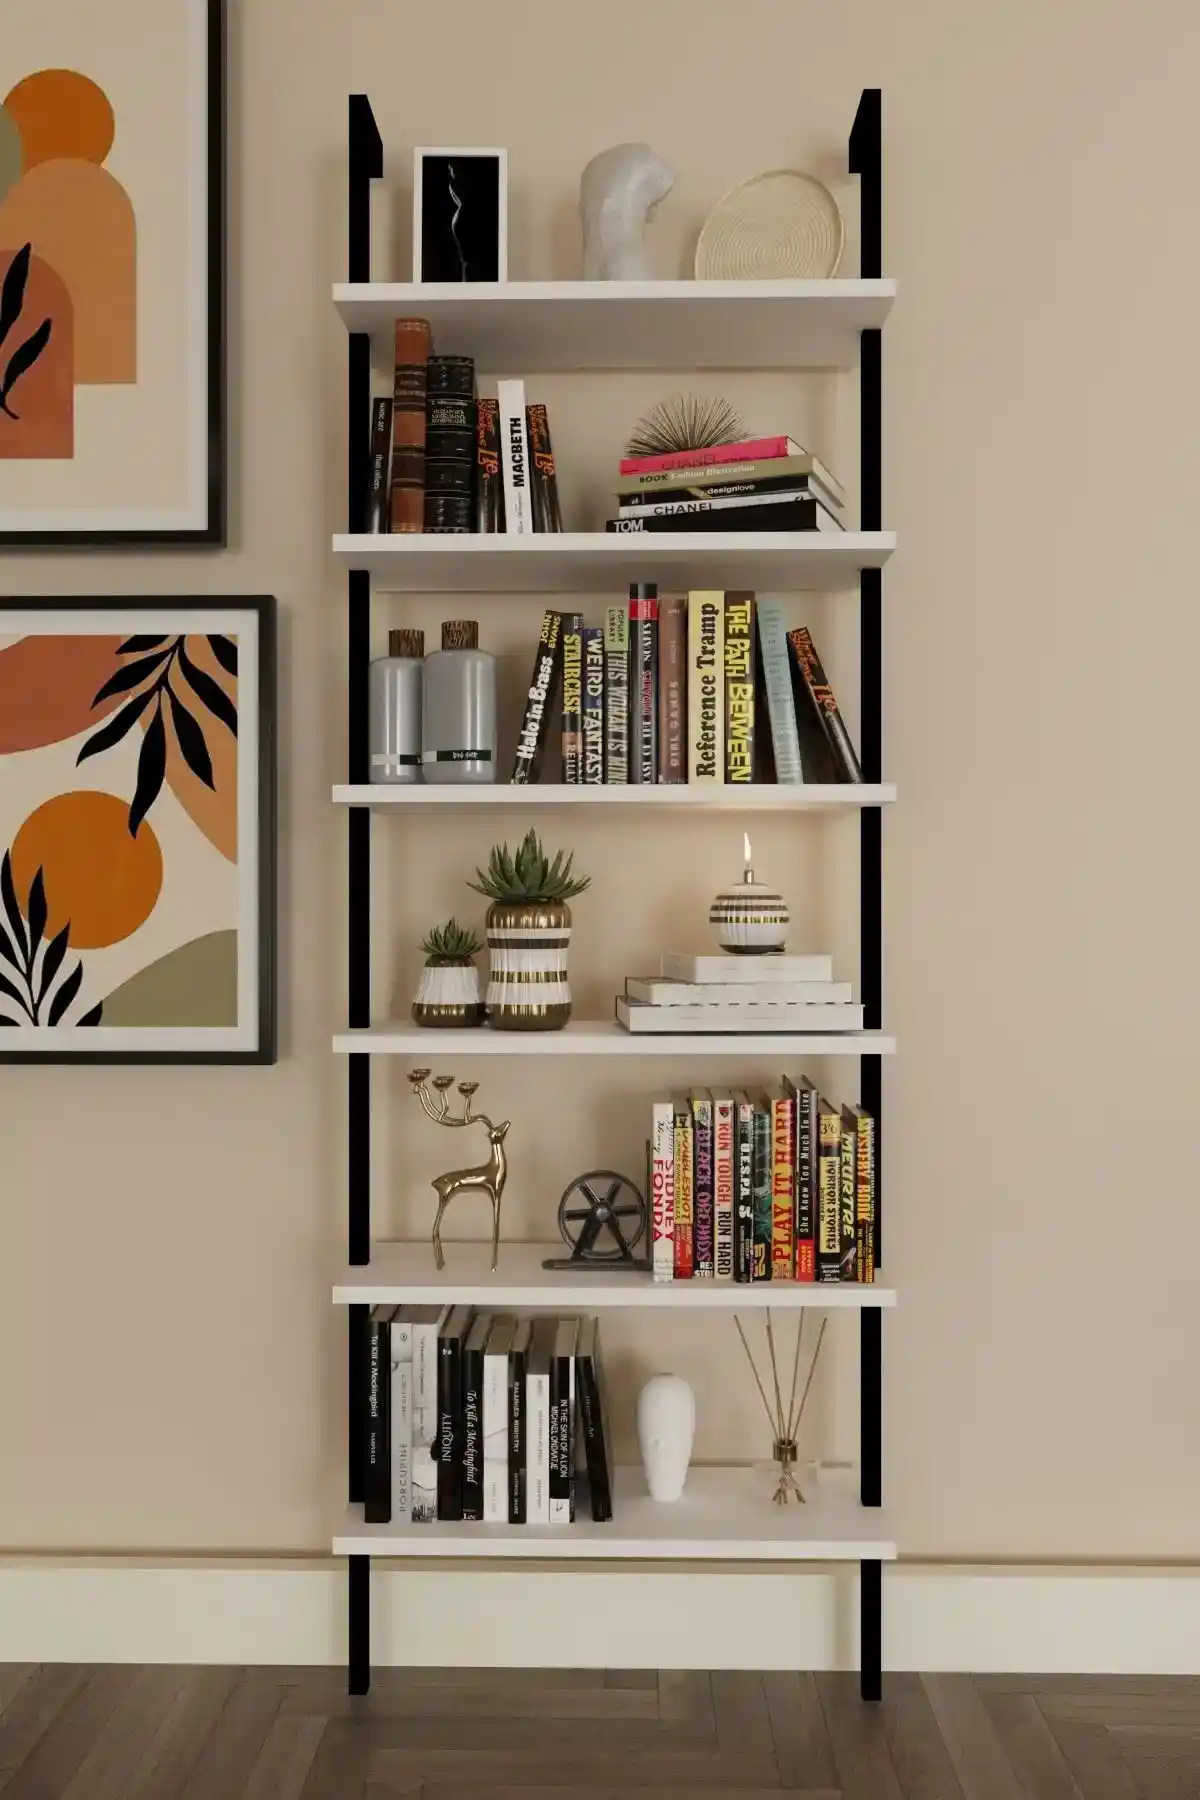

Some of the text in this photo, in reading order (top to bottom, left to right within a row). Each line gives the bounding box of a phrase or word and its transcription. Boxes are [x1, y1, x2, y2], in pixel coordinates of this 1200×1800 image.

[509, 417, 524, 488] MACBETH
[707, 484, 755, 496] designlove
[613, 519, 644, 533] TOM
[540, 614, 553, 644] JOHN
[548, 615, 561, 648] EVANS
[608, 609, 616, 643] LIBRARY
[616, 609, 625, 644] POPULAR
[528, 656, 553, 700] Brass
[563, 634, 581, 714] STAIRCASE
[607, 652, 628, 681] THIS
[526, 703, 544, 719] in
[582, 638, 604, 784] WEIRD FANTASY
[607, 686, 628, 732] WOMAN
[696, 602, 720, 778] Reference Tramp
[723, 600, 754, 782] THE PATH BETWEEN
[516, 722, 540, 759] Halo
[607, 736, 628, 751] IS
[670, 735, 680, 767] GIRL
[773, 1099, 792, 1166] HARD
[681, 1130, 691, 1221] DOUBLESHOT
[696, 1129, 712, 1186] BLACK
[800, 1093, 809, 1233] She Knew Too Much To Live
[857, 1118, 870, 1222] MYSTERY BOOK
[653, 1160, 664, 1242] FONDA
[716, 1123, 732, 1275] RUN TOUGH, RUN HARD
[773, 1173, 792, 1196] IT
[825, 1160, 837, 1204] HORROR
[841, 1133, 855, 1239] MEURTRE
[696, 1192, 712, 1262] ORCHIDS
[773, 1204, 792, 1261] PLAY
[825, 1207, 837, 1250] STORIES
[370, 1335, 379, 1344] To
[370, 1346, 379, 1359] Kill
[369, 1367, 379, 1418] Mockingbird
[464, 1403, 478, 1421] Kill
[466, 1391, 477, 1402] To
[560, 1399, 568, 1407] IN
[550, 1406, 559, 1434] MICHAEL
[560, 1408, 568, 1422] THE
[560, 1424, 568, 1441] SKIN
[443, 1412, 454, 1462] INIQUITY
[462, 1429, 478, 1485] Mockingbird
[560, 1442, 568, 1453] OF
[399, 1442, 407, 1512] PORCUPINE
[560, 1460, 568, 1478] LION
